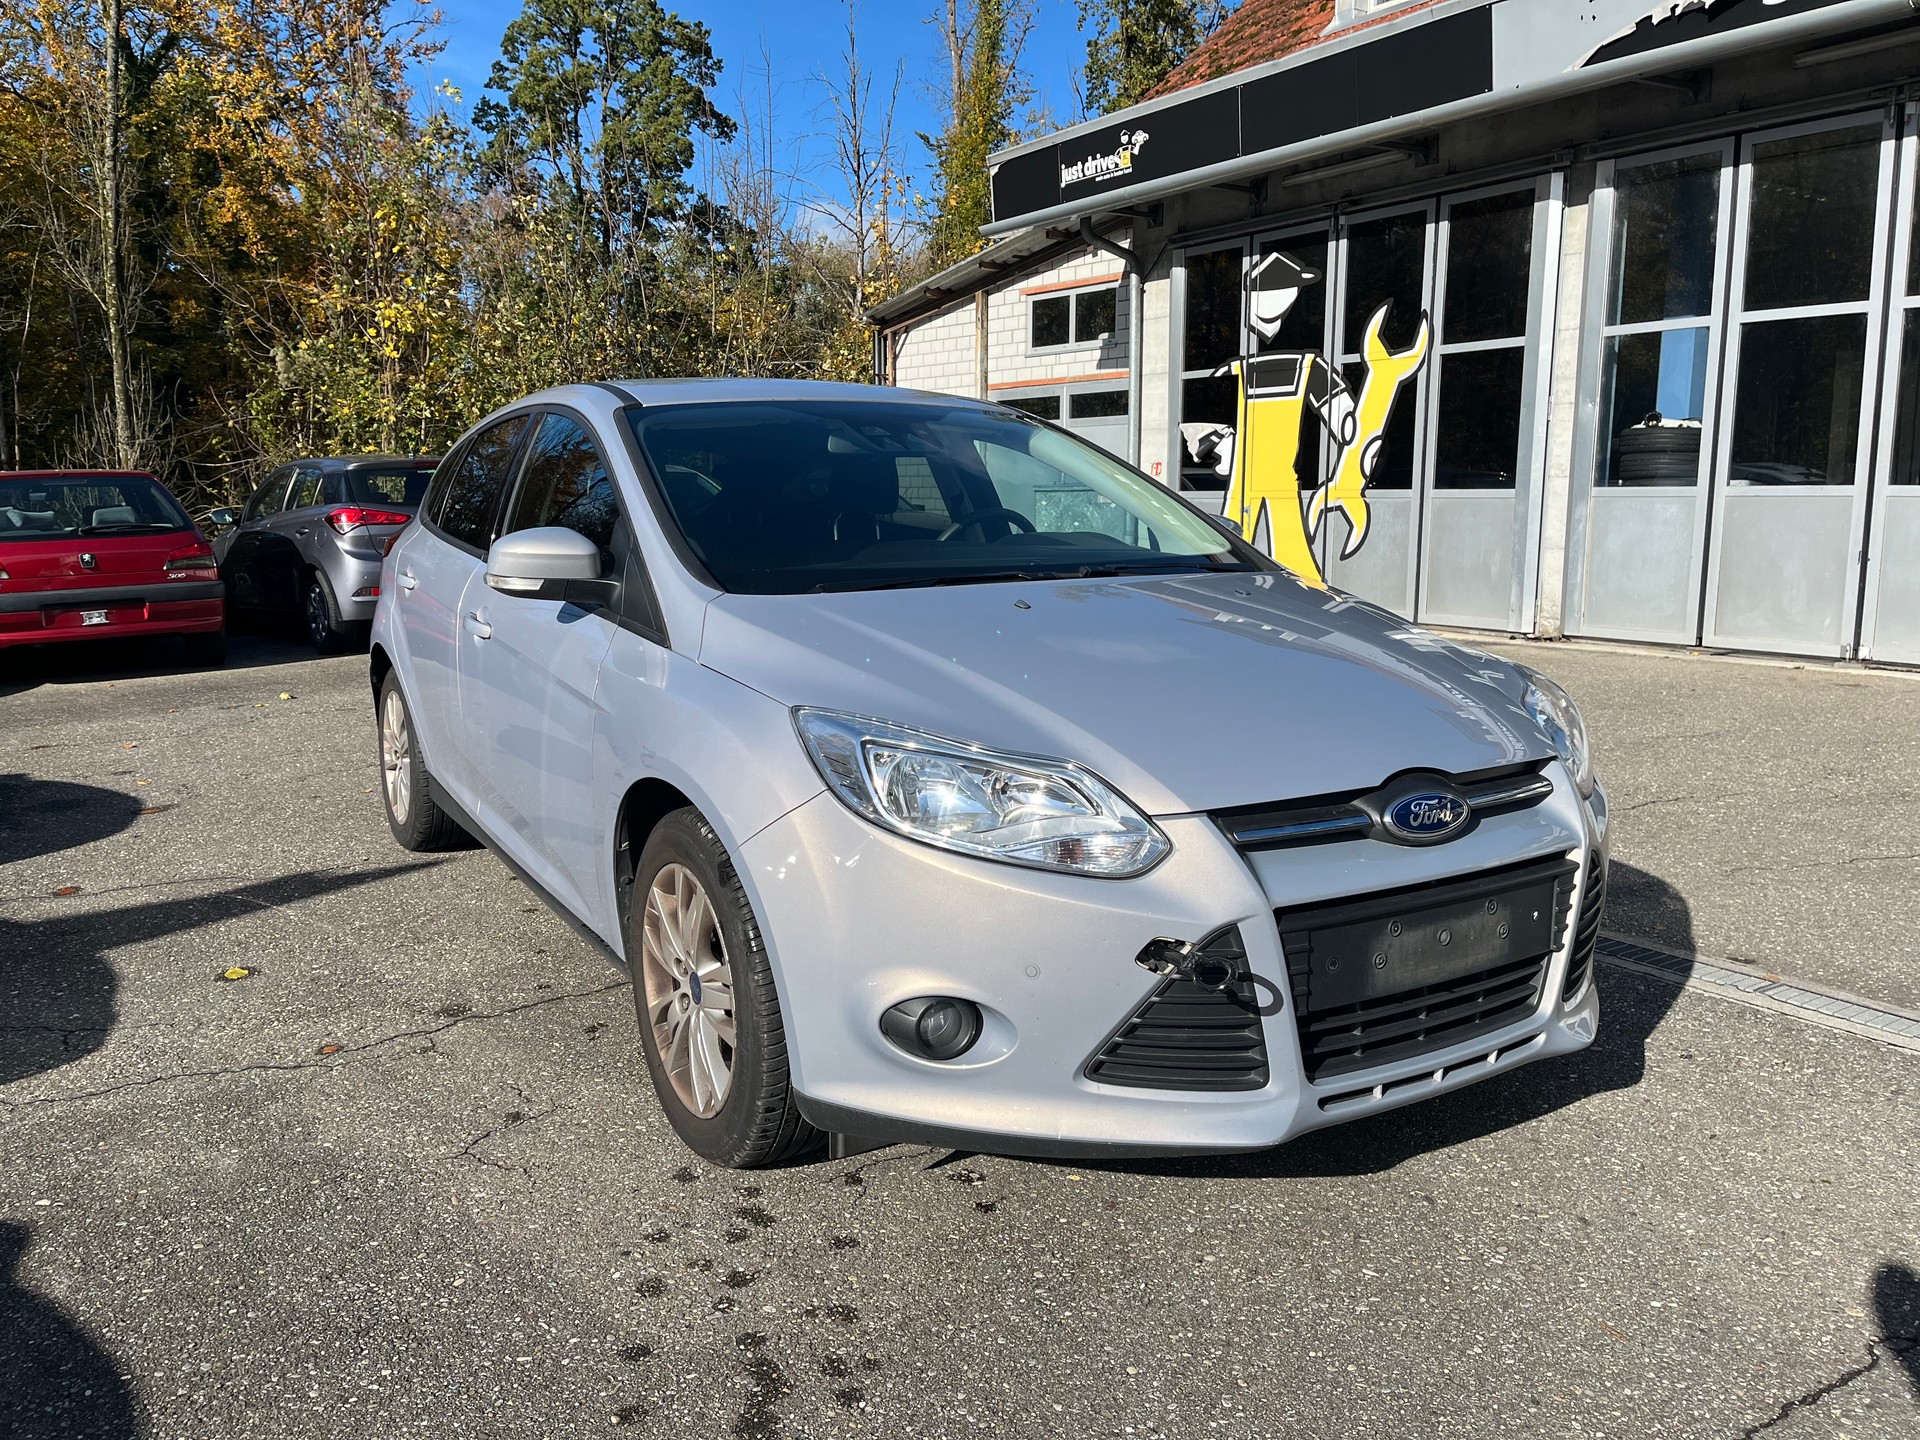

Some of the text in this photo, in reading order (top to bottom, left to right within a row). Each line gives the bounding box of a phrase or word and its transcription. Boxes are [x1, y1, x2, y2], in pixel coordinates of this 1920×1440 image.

[1061, 161, 1083, 188] just
[1084, 153, 1115, 176] drive
[1410, 799, 1453, 826] Ford
